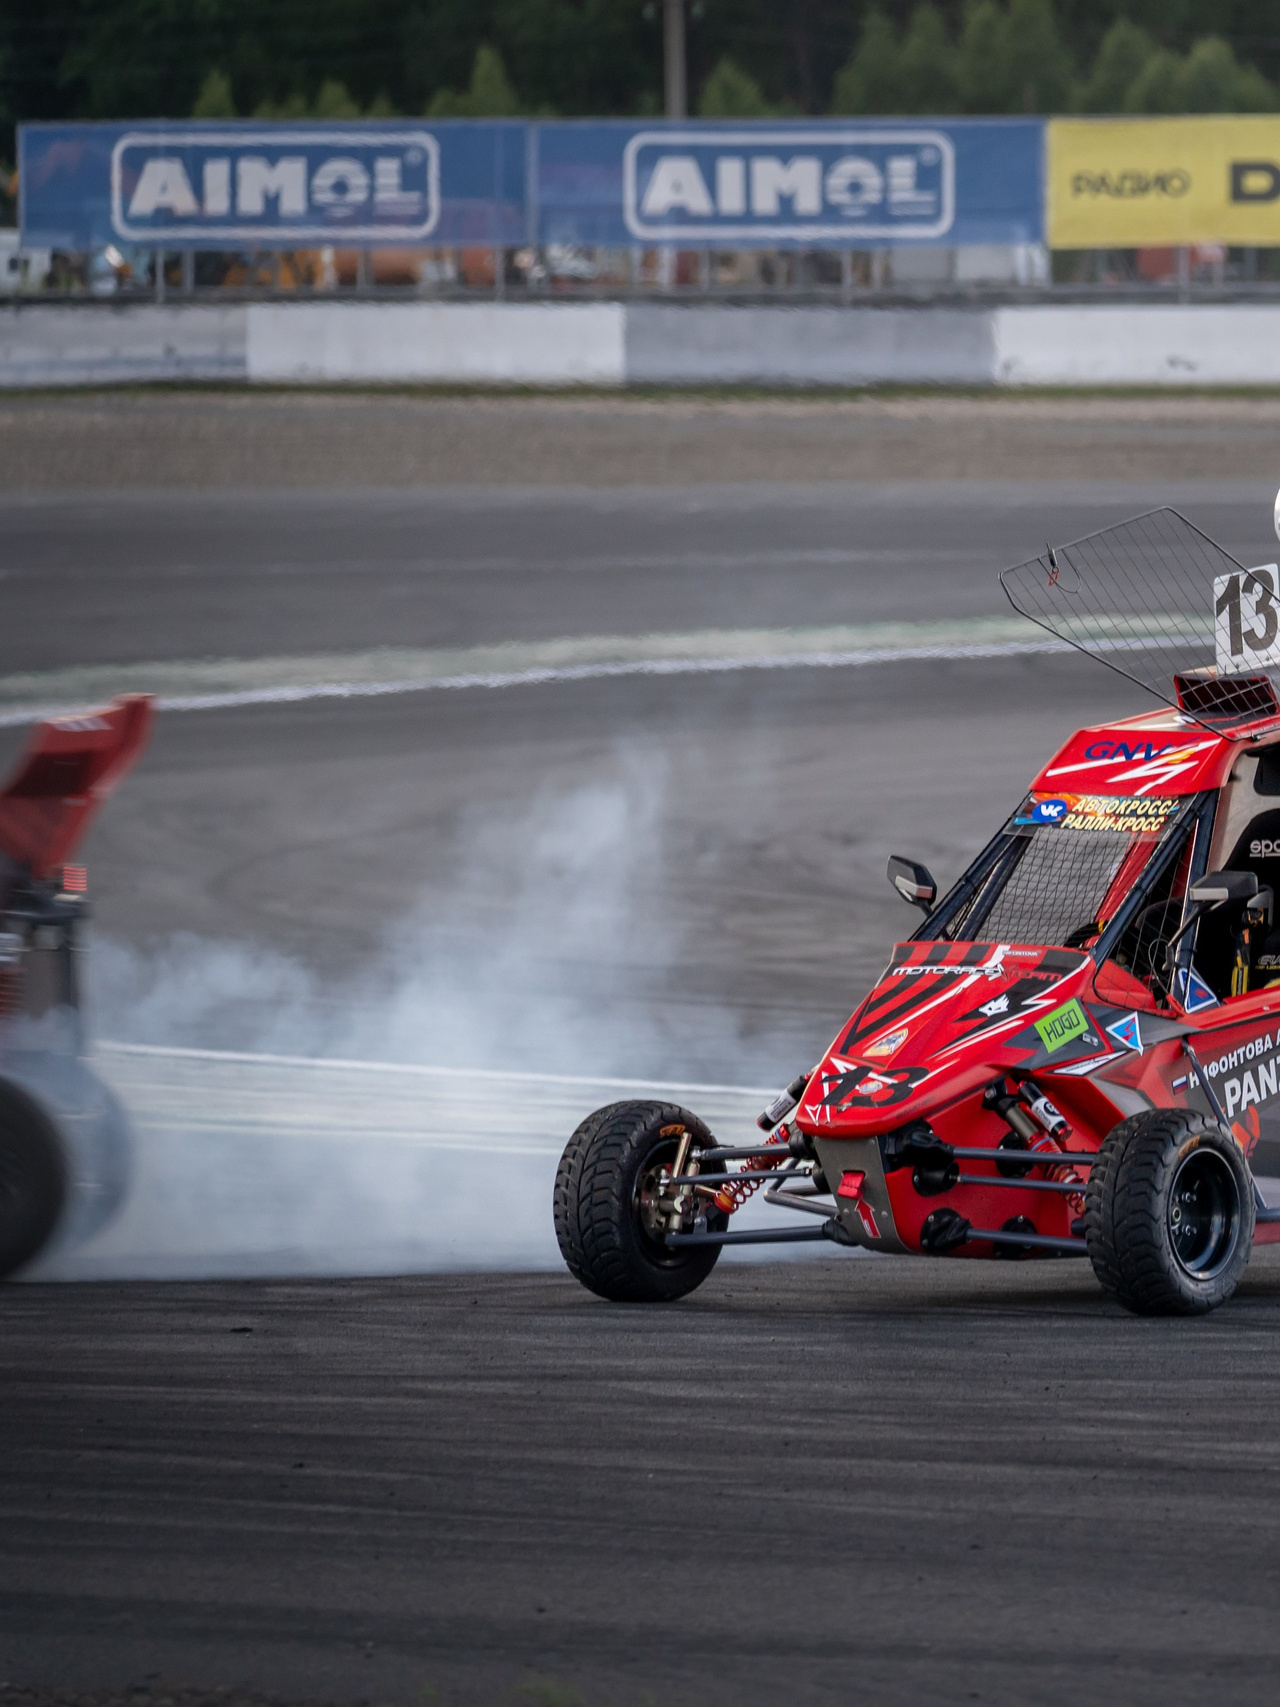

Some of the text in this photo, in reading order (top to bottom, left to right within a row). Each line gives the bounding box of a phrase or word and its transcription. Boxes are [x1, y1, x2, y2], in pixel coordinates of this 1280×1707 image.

[128, 156, 421, 217] AIMOL
[641, 156, 936, 217] AIMOL
[1072, 168, 1191, 200] РАДИО
[1216, 569, 1278, 657] 13
[1060, 814, 1165, 832] РАЛЛИ-КРОСС
[819, 1066, 930, 1107] 13
